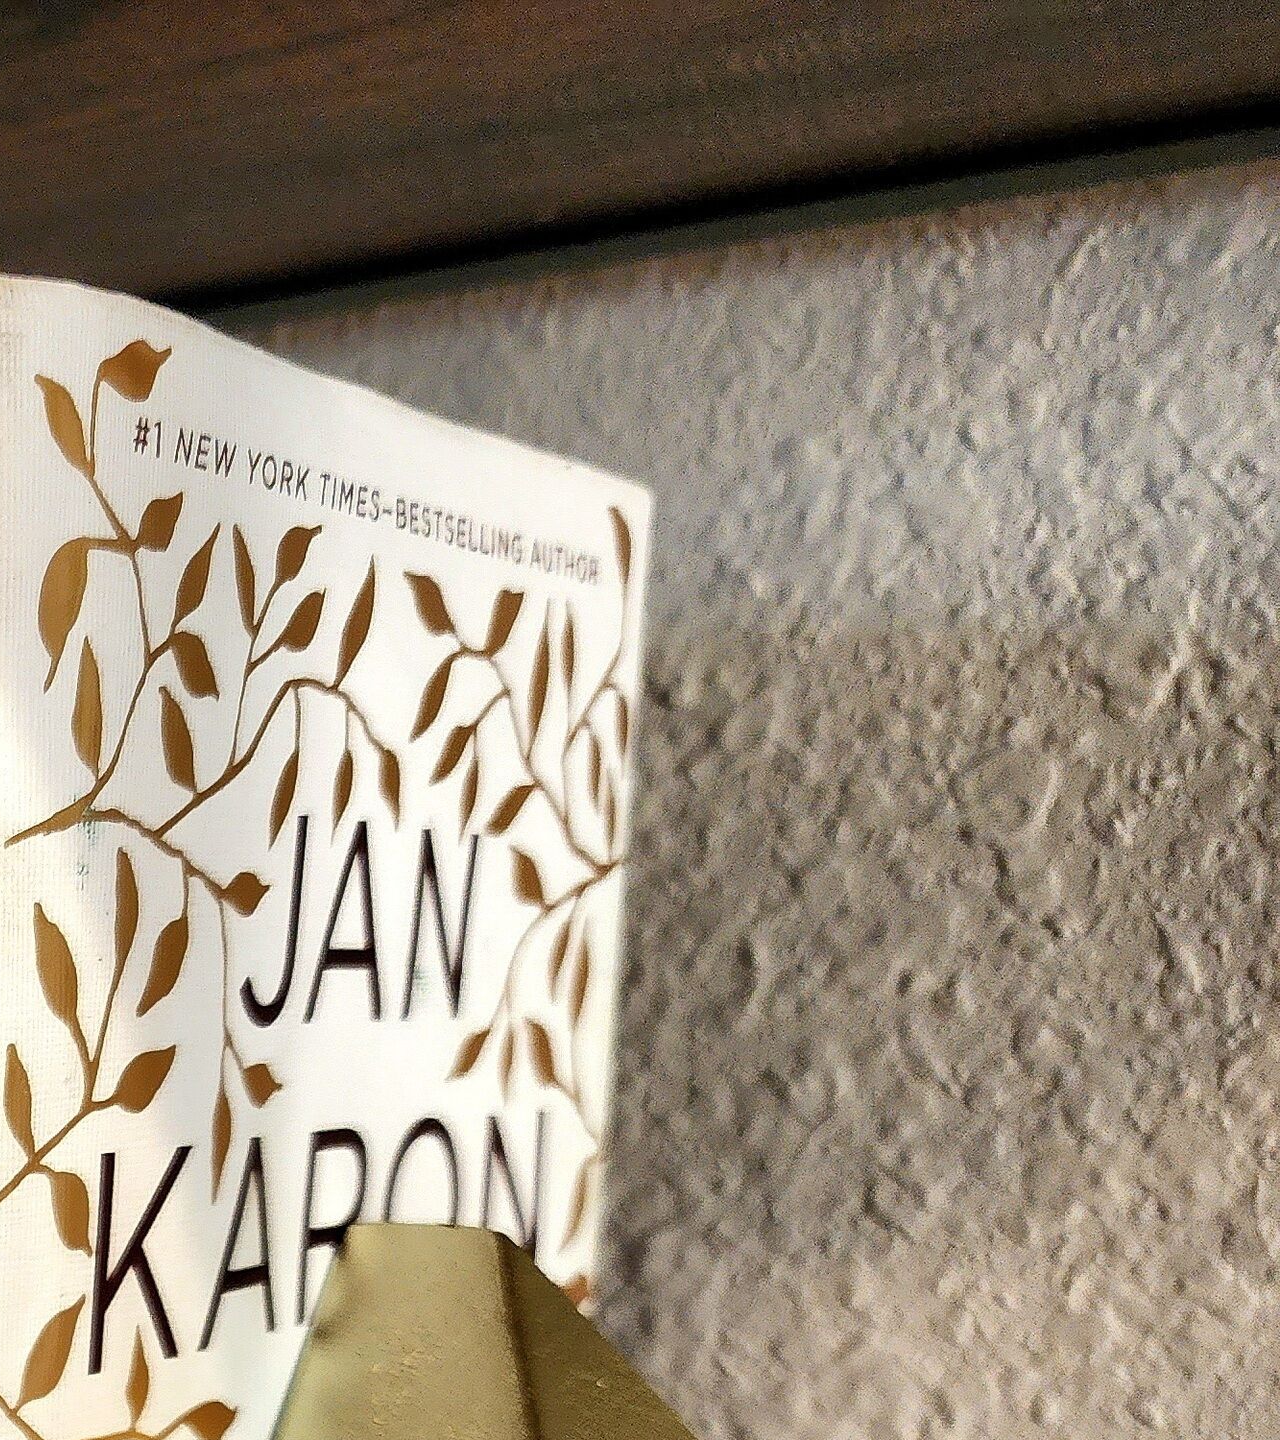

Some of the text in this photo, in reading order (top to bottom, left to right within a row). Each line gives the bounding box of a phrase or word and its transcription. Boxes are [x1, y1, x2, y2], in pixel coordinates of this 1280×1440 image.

[133, 416, 164, 460] #1
[173, 426, 238, 479] NEW
[245, 447, 309, 502] YORK
[530, 534, 602, 588] AUTHOR
[239, 812, 481, 1030] JAN
